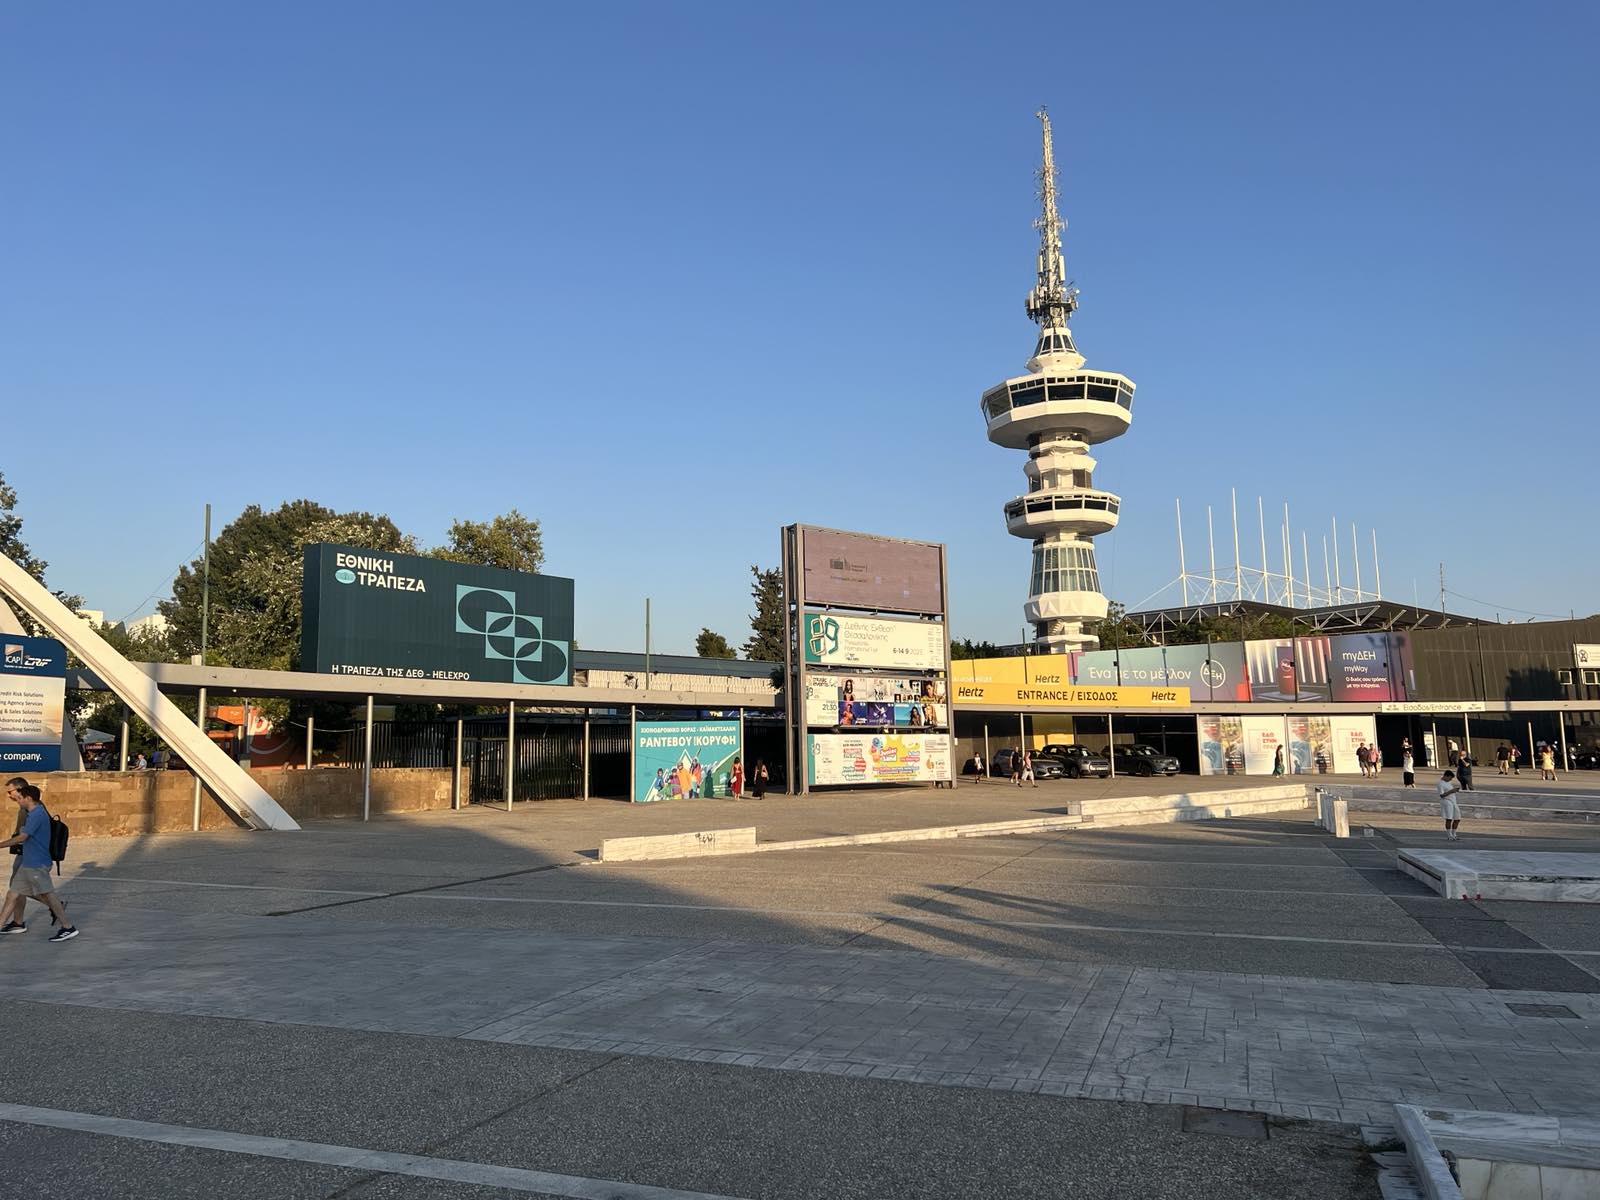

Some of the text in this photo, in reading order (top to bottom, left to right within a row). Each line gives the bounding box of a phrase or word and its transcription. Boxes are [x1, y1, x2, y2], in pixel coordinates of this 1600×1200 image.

[336, 552, 394, 574] ΕΘΝΙΚΗ
[357, 571, 426, 593] ΤΡΑΠΕΖΑ
[5, 655, 21, 664] ICAP
[331, 664, 339, 673] Η
[341, 665, 383, 676] ΤΡΑΠΕΖΑ
[386, 667, 404, 677] ΤΗΣ
[405, 669, 424, 678] ΔΕΘ
[432, 670, 470, 680] HELEXPO
[1088, 667, 1111, 679] Ένα
[1132, 670, 1147, 679] το
[1150, 667, 1192, 682] μέλον
[1344, 665, 1369, 673] myWay
[1035, 674, 1060, 684] Hertz
[958, 686, 984, 697] Hertz
[1017, 690, 1118, 701] ENTRANCE / ΕΙΣΟΔΟΣ
[1151, 690, 1176, 701] Hertz
[640, 736, 692, 748] ΡΑΝΤΕΒΟΥ
[696, 735, 736, 746] ΚΟΡΥΦΗ
[3, 752, 42, 762] company.
